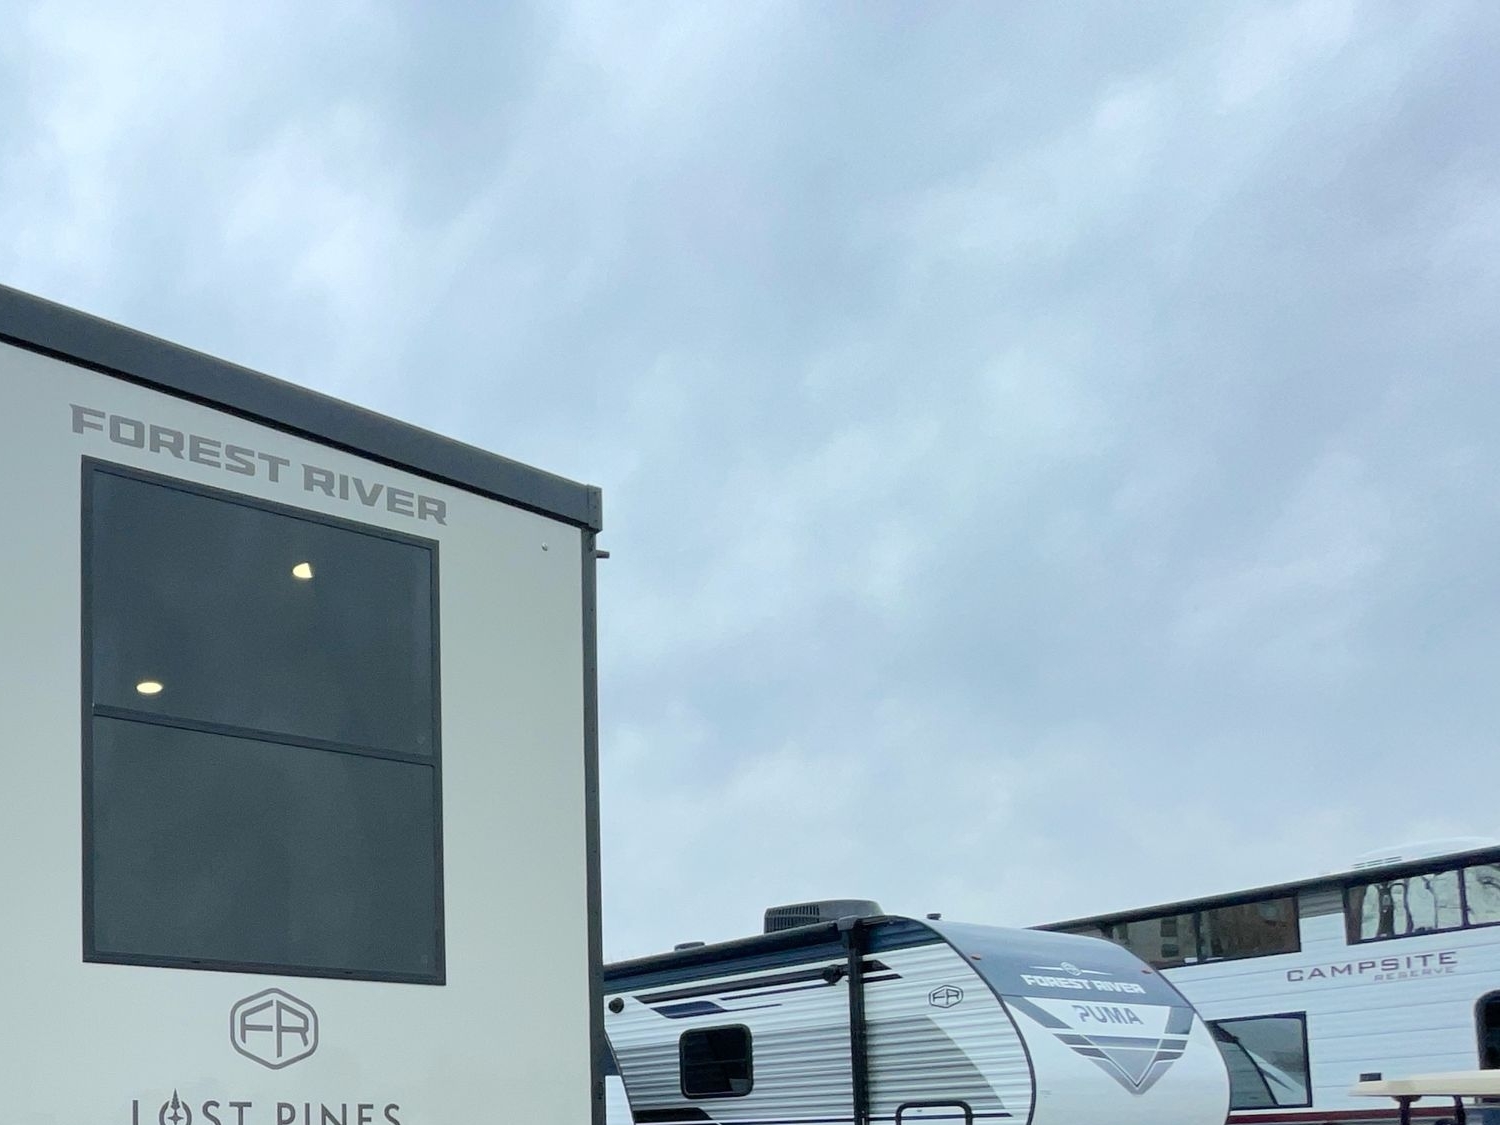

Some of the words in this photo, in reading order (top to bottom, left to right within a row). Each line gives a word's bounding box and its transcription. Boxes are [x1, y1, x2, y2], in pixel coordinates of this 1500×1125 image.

[69, 403, 290, 483] FOREST
[301, 463, 447, 526] RIVER
[1287, 951, 1458, 983] CAMPSITE
[1374, 966, 1456, 982] RESERVE
[1020, 974, 1092, 990] FOREST
[1091, 979, 1146, 995] RIVER
[1072, 1004, 1144, 1025] PUMA
